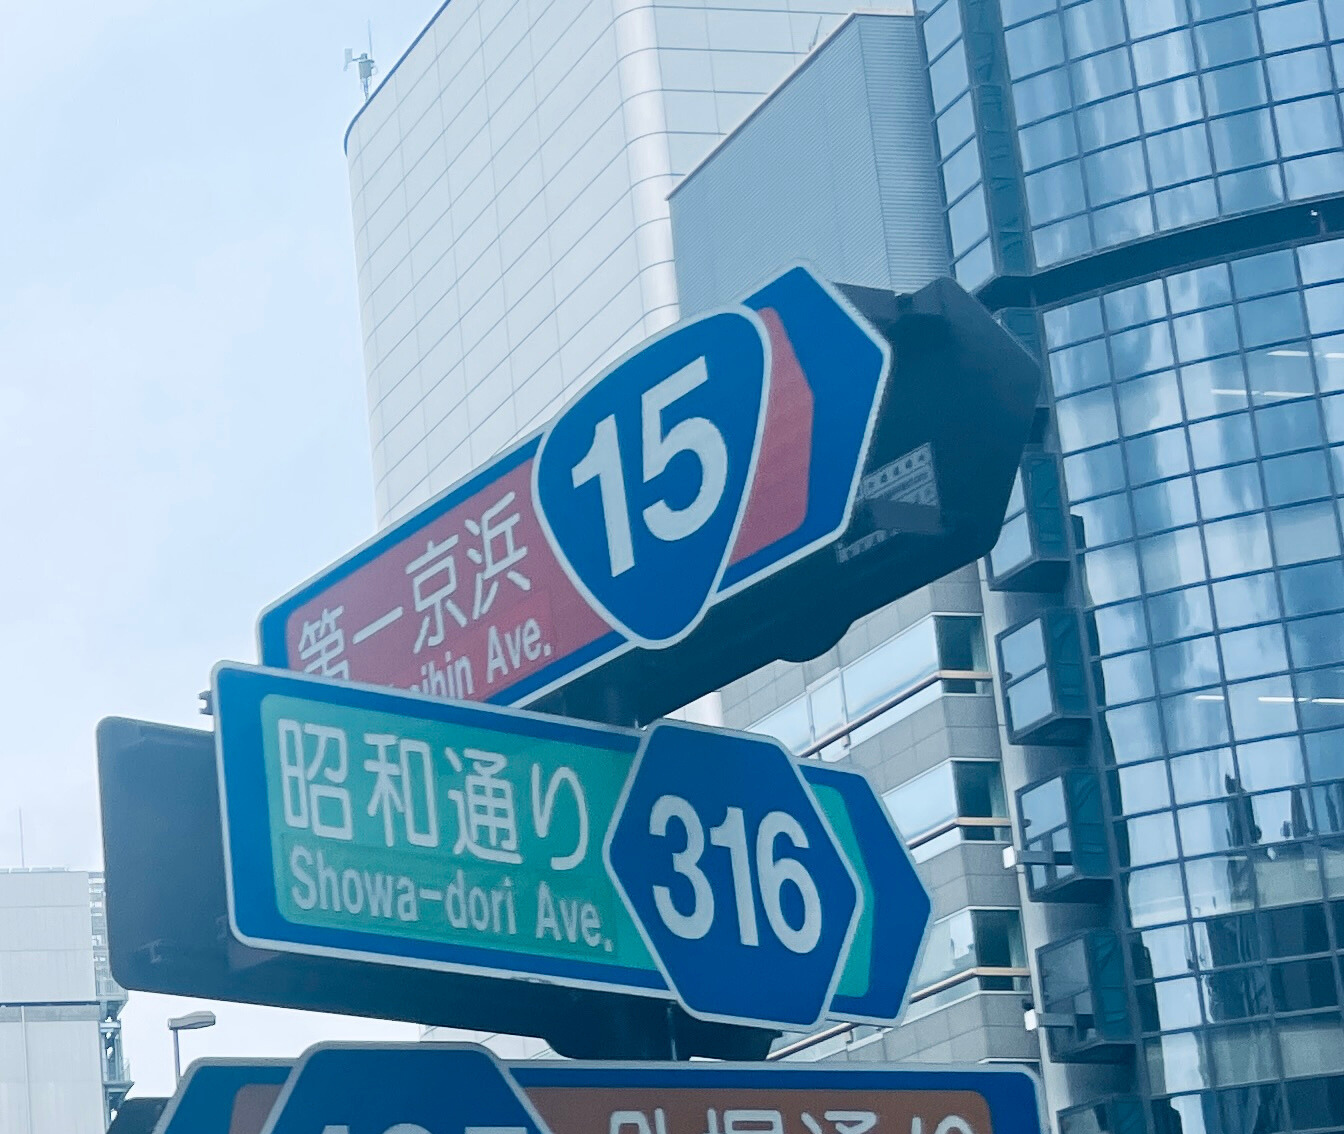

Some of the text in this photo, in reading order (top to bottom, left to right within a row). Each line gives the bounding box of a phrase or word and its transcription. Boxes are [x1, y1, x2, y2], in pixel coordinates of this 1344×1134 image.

[571, 355, 728, 578] 15
[297, 492, 532, 681] 第一京浜
[486, 618, 552, 683] Ave.
[276, 717, 590, 871] 昭和通り
[289, 845, 615, 953] Showa-dori Ave.
[648, 794, 823, 954] 316
